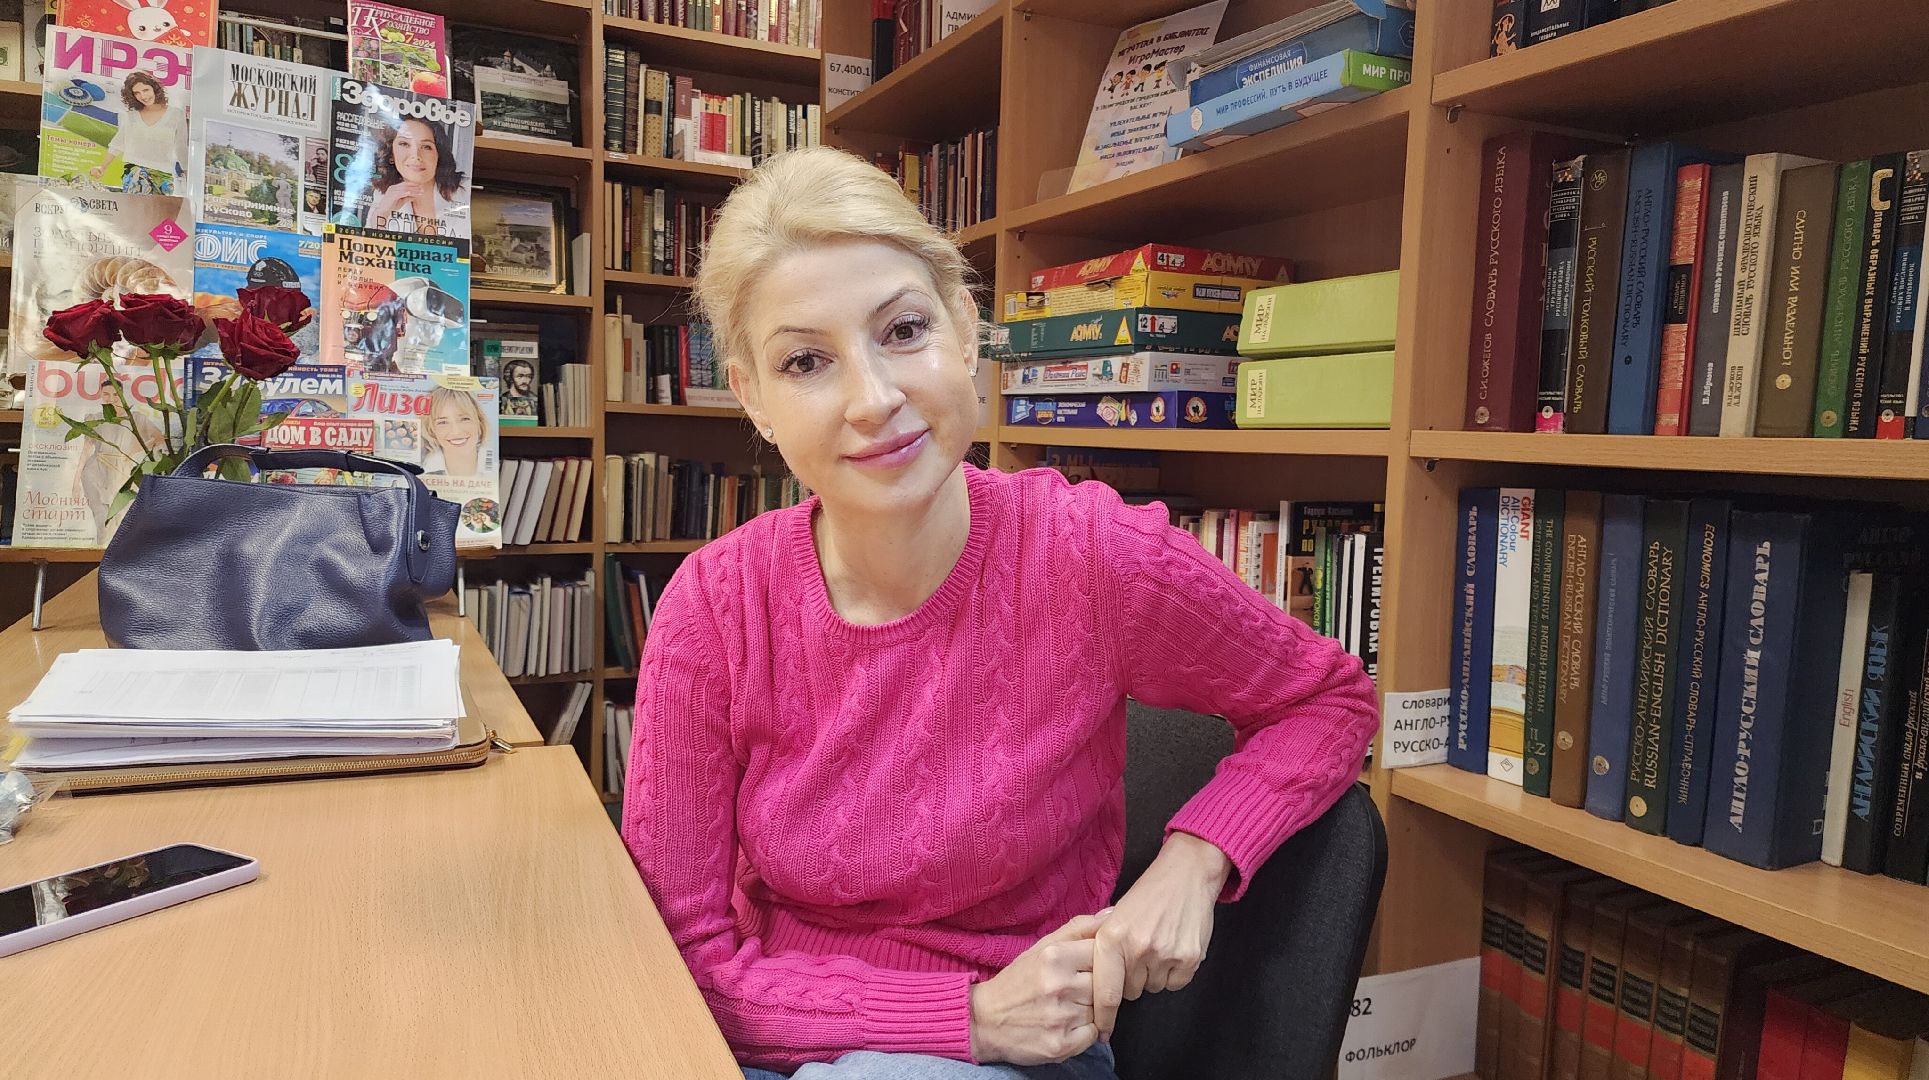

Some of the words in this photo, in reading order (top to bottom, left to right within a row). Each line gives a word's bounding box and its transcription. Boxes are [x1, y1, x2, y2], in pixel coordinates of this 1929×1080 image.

[405, 30, 413, 43] 7
[413, 38, 436, 49] 2024
[947, 23, 961, 32] ПР
[829, 62, 871, 77] 67.400.1
[1127, 44, 1186, 66] ИгроМастер
[1241, 55, 1304, 89] ЭКСПЕДИЦИЯ
[1248, 49, 1292, 72] ФИНАНСОВАЯ
[1362, 63, 1387, 79] МИР
[1388, 70, 1412, 84] ПРО
[229, 62, 318, 95] МОСКОВСКИЙ
[828, 87, 865, 98] КОНСТИТ
[1216, 105, 1230, 117] МИР
[1269, 86, 1287, 98] ПУТЬ
[1294, 69, 1329, 90] БУДУЩЕЕ
[228, 82, 318, 122] ЖУРНАЛ
[341, 80, 472, 128] Здоровье
[1494, 145, 1507, 194] ЯЗЫКА
[35, 202, 64, 214] ВОКРУ
[88, 198, 119, 213] СВЕТА
[205, 194, 295, 215] Госеприимное
[205, 204, 253, 218] Кусково
[391, 210, 447, 228] ЕКАТЕРИНА
[1752, 204, 1764, 238] ЯЗЫКА
[163, 224, 173, 235] 9
[195, 233, 267, 265] ФИС
[196, 228, 236, 237] ИЗКУЛЬТУРА
[1489, 197, 1502, 266] РУССКОГО
[1792, 209, 1806, 261] СЛИТНО
[338, 237, 454, 264] Популярная
[338, 250, 432, 275] Механика
[1158, 253, 1166, 263] 4
[1584, 236, 1597, 293] РУССКИЙ
[1746, 241, 1759, 290] РУССКОГО
[1789, 266, 1800, 297] ИЛИ
[1864, 247, 1879, 297] ОБРАЗНЫХ
[1484, 267, 1498, 327] СЛОВАРЬ
[1620, 279, 1632, 348] DICTIONARY
[1632, 281, 1645, 329] СЛОВАРЬ
[1733, 279, 1746, 337] ШКОЛЬНЫЙ
[1741, 293, 1754, 337] СЛОВАРЬ
[1139, 316, 1149, 329] 12
[1254, 304, 1266, 335] МИР
[1577, 297, 1592, 360] ТОЛКОВЫЙ
[1858, 297, 1874, 355] ВЫРАЖЕНИЙ
[1250, 378, 1258, 409] МИР
[1573, 364, 1585, 414] СЛОВАРЬ
[1853, 356, 1867, 399] РУССКОГО
[353, 383, 434, 416] Лиза
[1848, 400, 1861, 433] ЯЗЫКА
[265, 424, 306, 447] ДОМ
[309, 426, 322, 447] В
[324, 426, 374, 448] САДУ
[22, 490, 91, 507] Модный
[424, 478, 450, 488] СЕНЬ
[452, 479, 466, 488] НА
[467, 480, 493, 490] ДАЧЕ
[22, 505, 87, 528] старт
[1499, 495, 1511, 568] DICTIONARY
[1508, 496, 1520, 553] All-Colour
[1520, 496, 1532, 541] GIANT
[1545, 519, 1554, 539] THE
[1466, 505, 1478, 578] СЛОВАРЬ
[1699, 523, 1716, 591] ECONOMICS
[1541, 540, 1552, 621] COMPREHENSIVE
[1563, 534, 1576, 632] ENGLISH-RUSSIAN
[1572, 534, 1587, 634] АНГЛО-РУССКИЙ
[1312, 592, 1322, 627] УРОКОВ
[1690, 591, 1709, 679] АНГЛО-РУССКИЙ
[1867, 624, 1889, 682] ЯЗЫК
[1537, 625, 1549, 713] ENGLISH-RUSSIAN
[1559, 634, 1571, 705] DICTIONARY
[1570, 639, 1582, 690] СЛОВАРЬ
[1630, 616, 1654, 783] РУССКО-АНГЛИЙСКИЙ
[1645, 540, 1660, 611] СЛОВАРЬ
[1644, 652, 1667, 790] RUSSIAN-ENGLISH
[1656, 546, 1673, 646] DICTIONARY
[1728, 648, 1762, 834] АНГЛО-РУССКИЙ
[1749, 540, 1771, 646] СЛОВАРЬ
[1838, 688, 1855, 728] English
[1677, 681, 1700, 806] СЛОВАРЬ-СПРАВОЧНИК
[1893, 761, 1911, 838] СОВРЕМЕННЫЙ
[1350, 997, 1372, 1018] 82
[1344, 1037, 1417, 1063] ФОЛЬКЛОР
